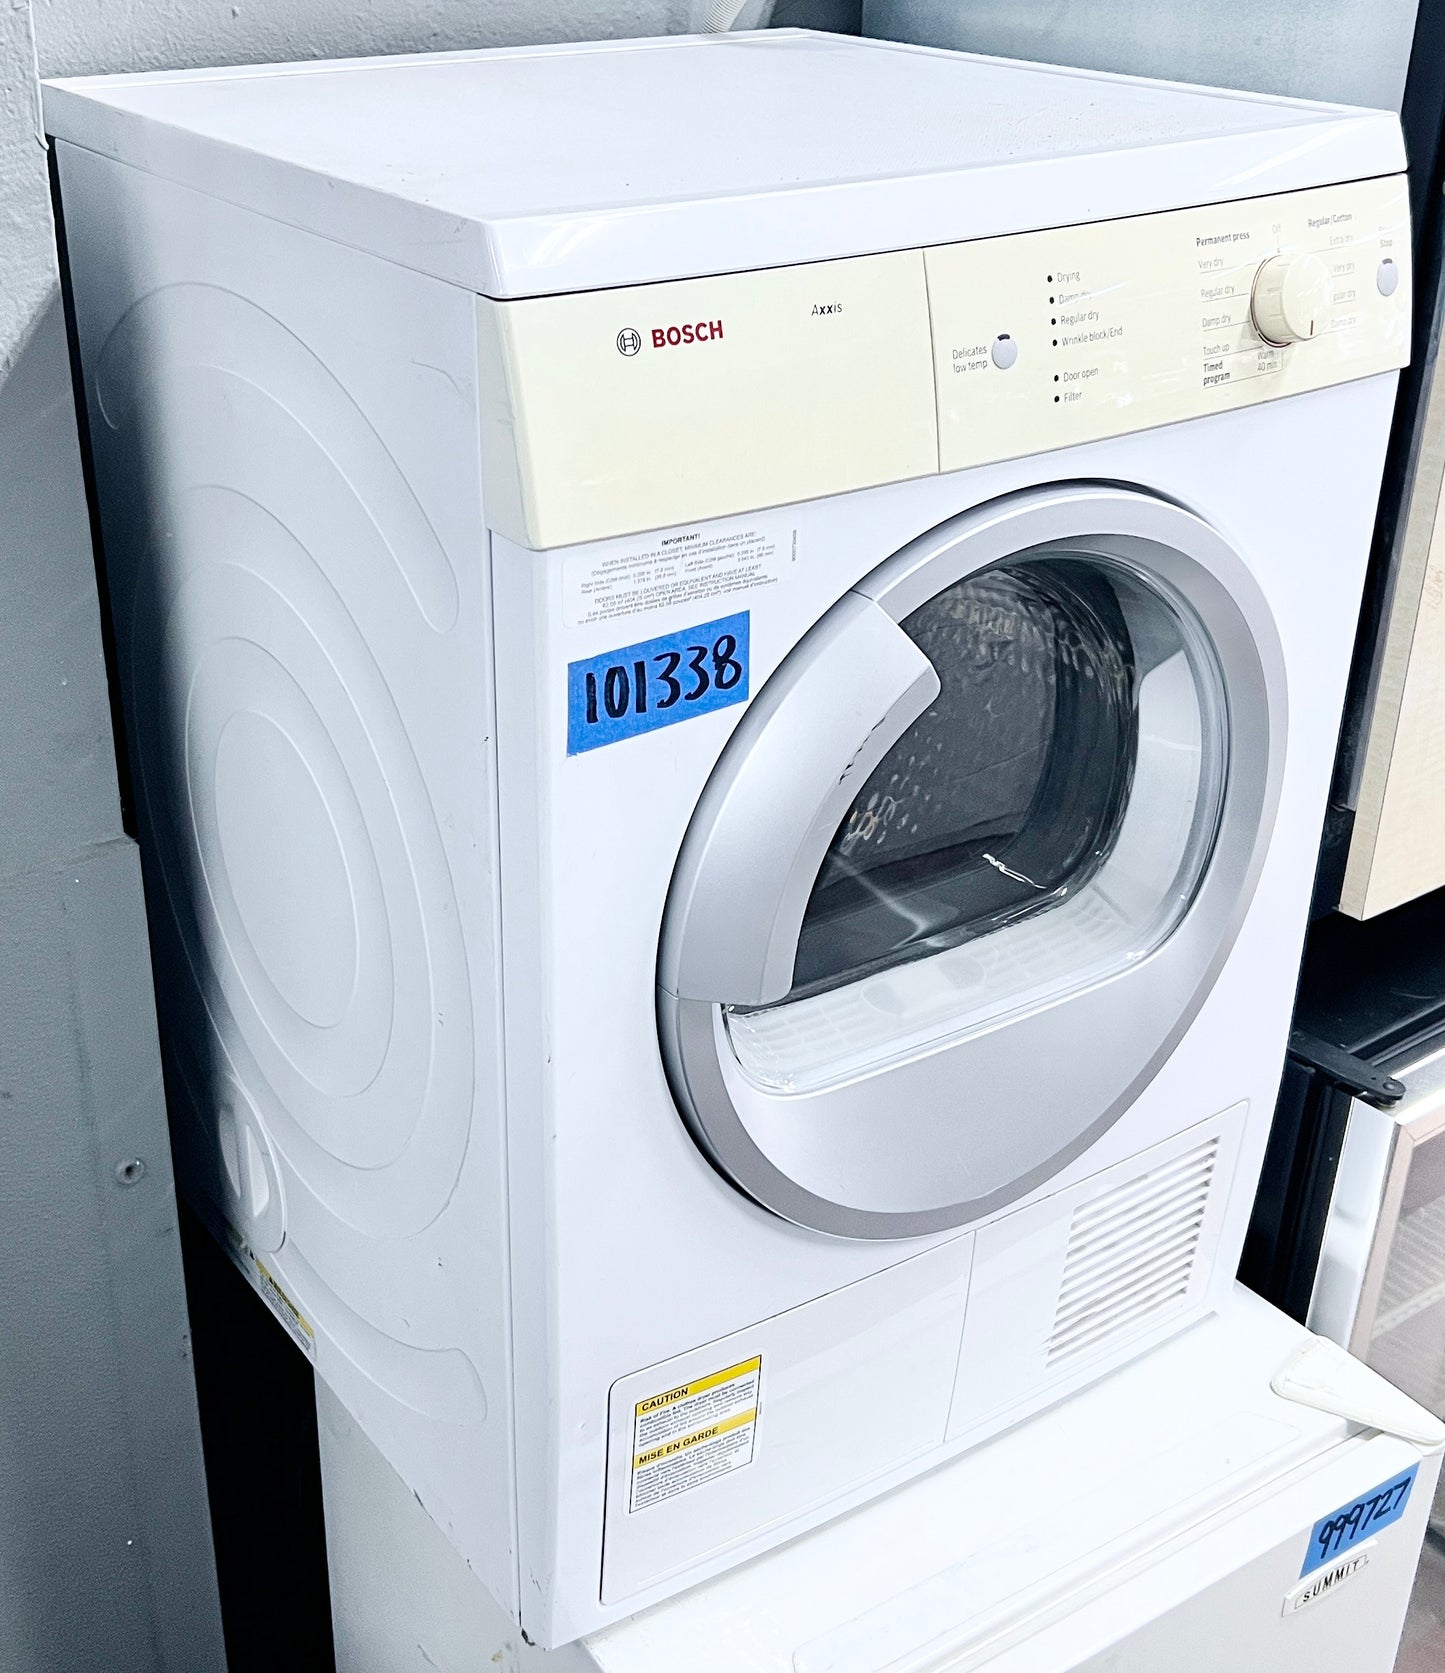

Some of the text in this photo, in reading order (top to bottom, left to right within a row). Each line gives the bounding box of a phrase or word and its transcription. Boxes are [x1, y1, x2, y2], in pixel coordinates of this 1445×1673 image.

[1197, 232, 1249, 246] Permanent press
[1380, 239, 1392, 247] Stop
[1198, 257, 1223, 269] Very dry
[1346, 262, 1355, 271] dry
[1057, 271, 1080, 282] Drying
[1201, 284, 1234, 298] Regular dry
[1346, 289, 1356, 298] dry
[811, 301, 842, 317] Axxis
[1060, 310, 1099, 326] Regular dry
[1202, 314, 1231, 327] Damp dry
[651, 320, 724, 348] BOSCH
[1062, 326, 1123, 347] Wrinkle block/End
[952, 345, 987, 359] Delicates
[1203, 345, 1230, 356] Touch up
[953, 360, 987, 373] low temp
[1204, 362, 1223, 372] Timed
[1257, 362, 1266, 371] 40
[1064, 367, 1099, 382] Door open
[1203, 372, 1230, 385] program
[1064, 391, 1082, 402] Filter
[662, 534, 700, 545] IMPORTANT!
[585, 634, 742, 724] 101338
[642, 1387, 688, 1412] CAUTION
[639, 1426, 719, 1464] MISE EN GARDE
[1318, 1476, 1411, 1559] 999727
[1303, 1559, 1359, 1603] SUMMIT
